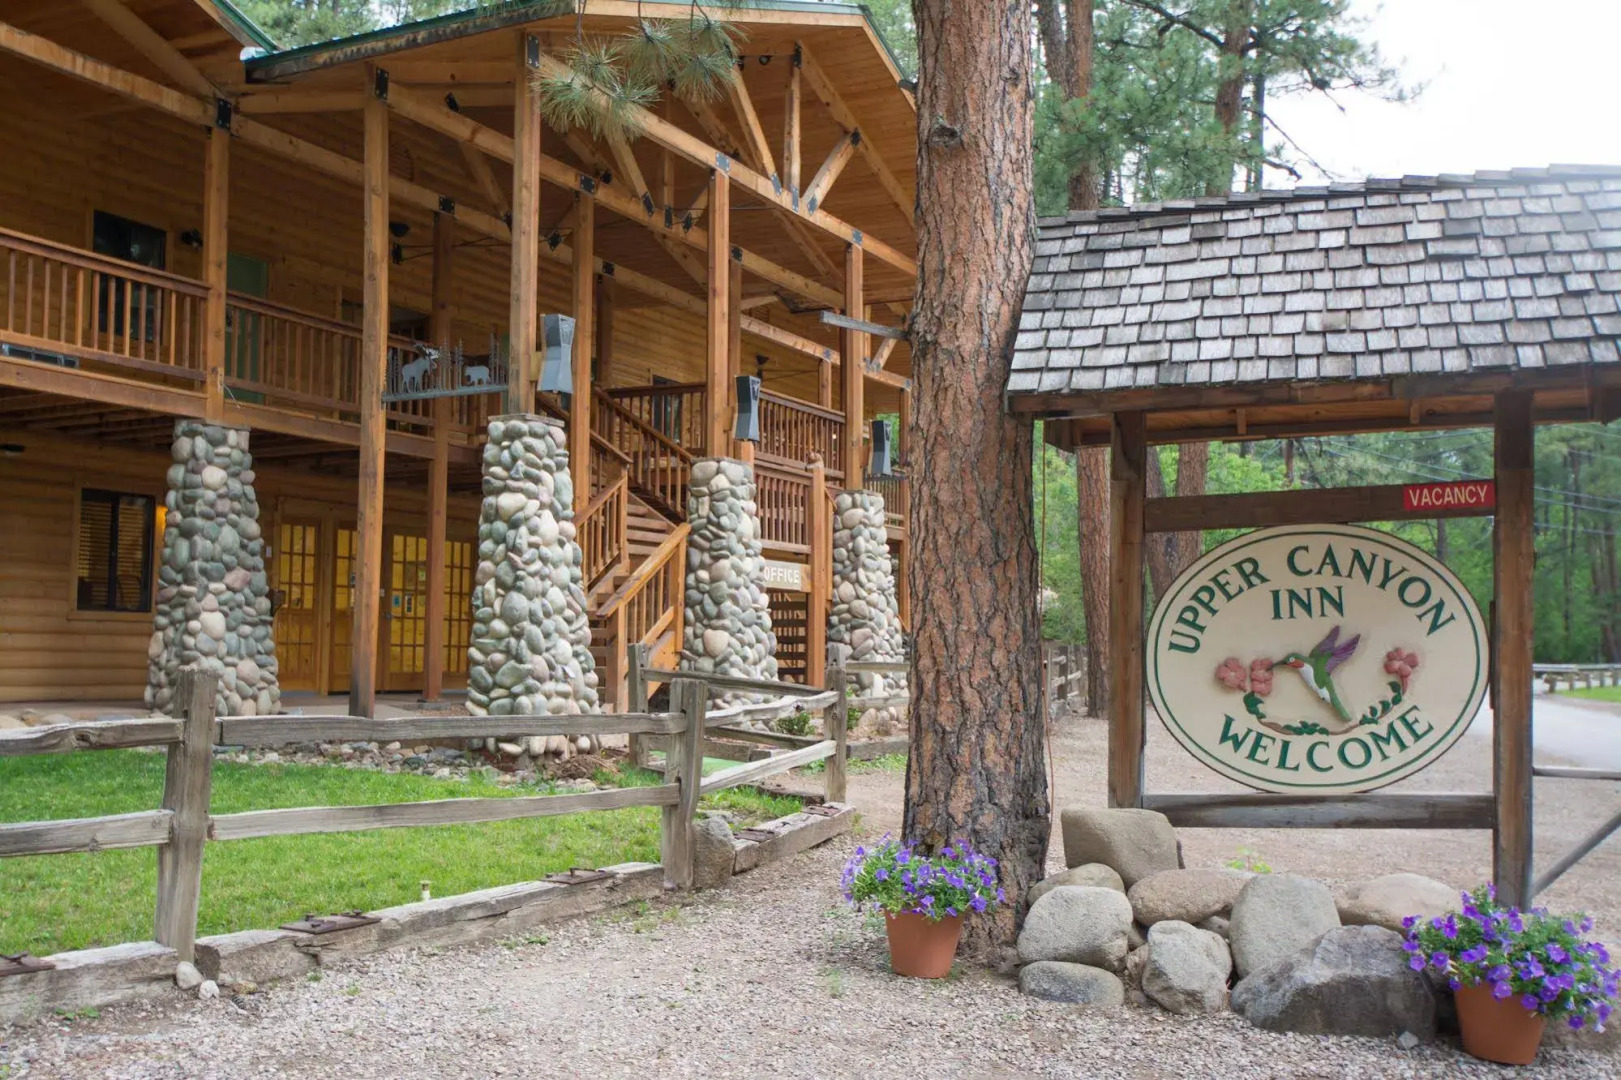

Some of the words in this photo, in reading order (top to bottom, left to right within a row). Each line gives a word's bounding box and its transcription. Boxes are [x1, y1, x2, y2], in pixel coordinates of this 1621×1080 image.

[1408, 484, 1488, 507] VACANCY
[763, 567, 800, 584] OFFICE
[1168, 556, 1270, 654] UPPER
[1286, 543, 1456, 637] CANYON
[1270, 585, 1346, 620] INN
[1218, 705, 1435, 773] WELCOME
